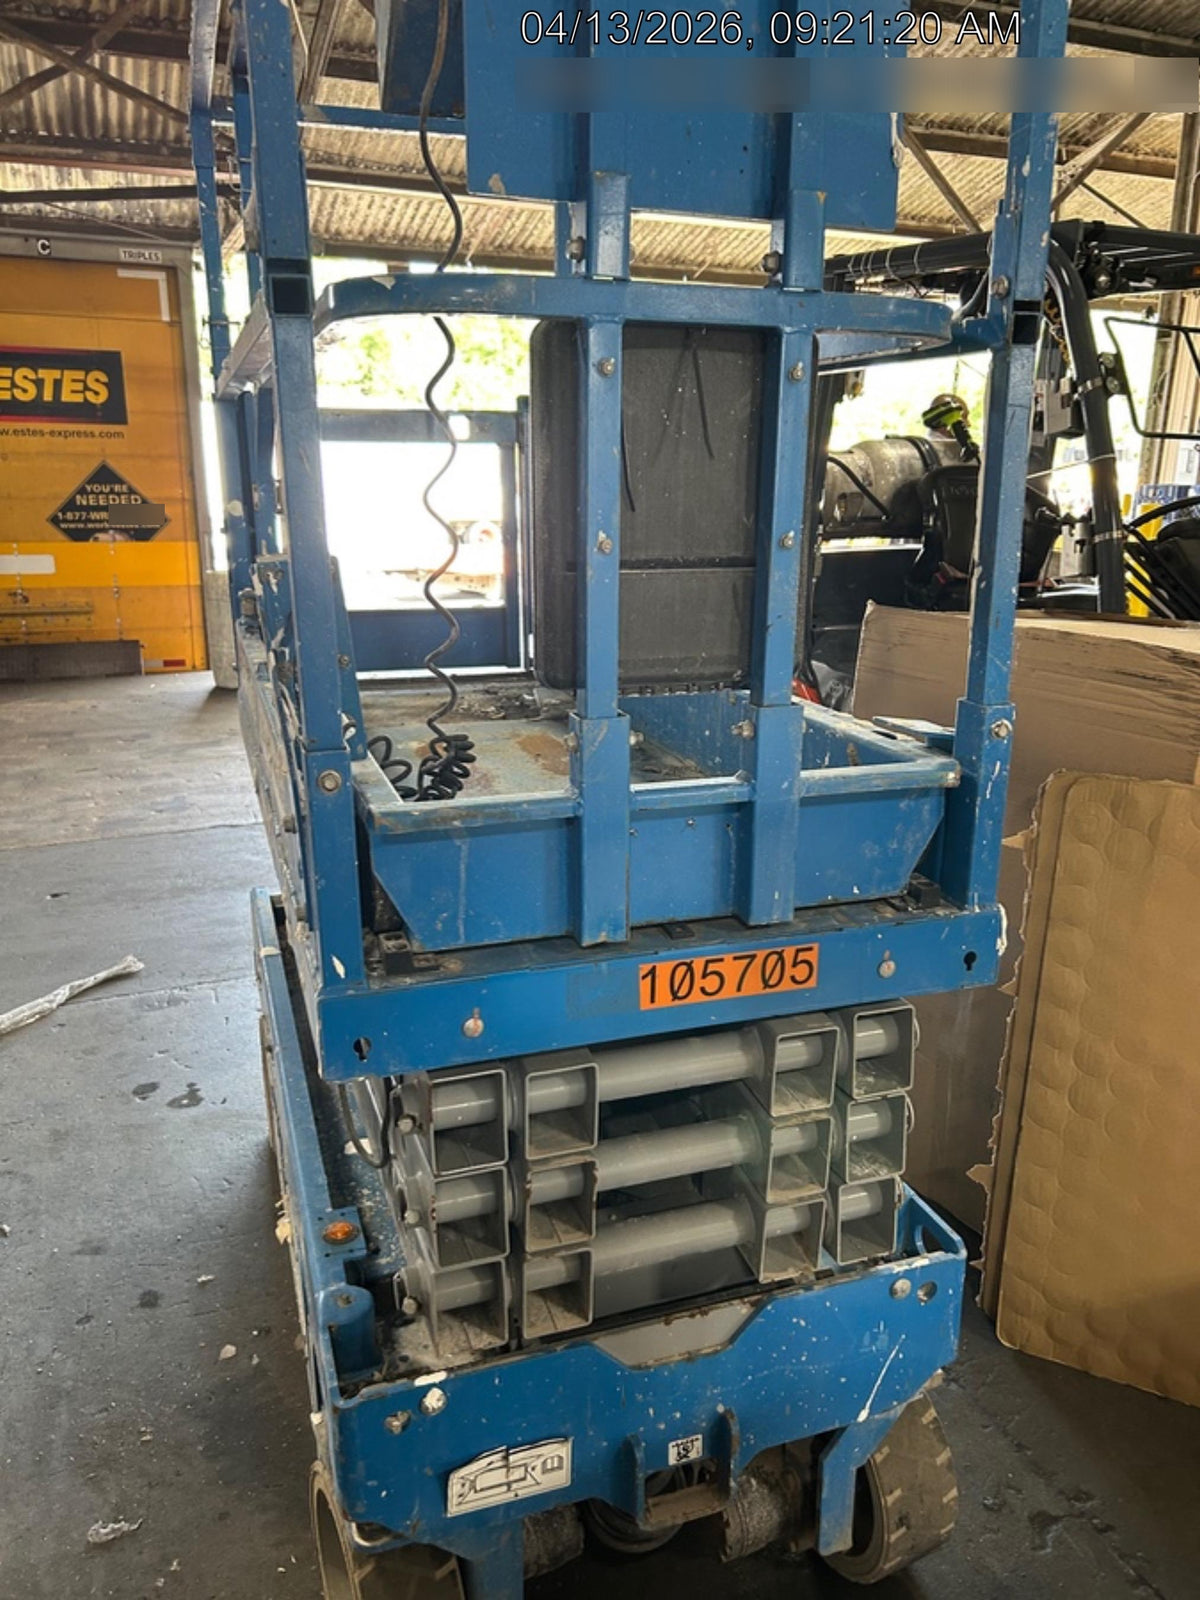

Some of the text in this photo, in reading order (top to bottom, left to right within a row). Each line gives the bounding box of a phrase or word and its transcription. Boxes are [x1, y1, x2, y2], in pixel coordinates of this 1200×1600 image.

[37, 239, 51, 255] C
[122, 250, 161, 262] TRIPLES
[0, 366, 110, 405] ESTES
[85, 483, 129, 493] YOU'RE
[75, 494, 142, 506] NEEDED
